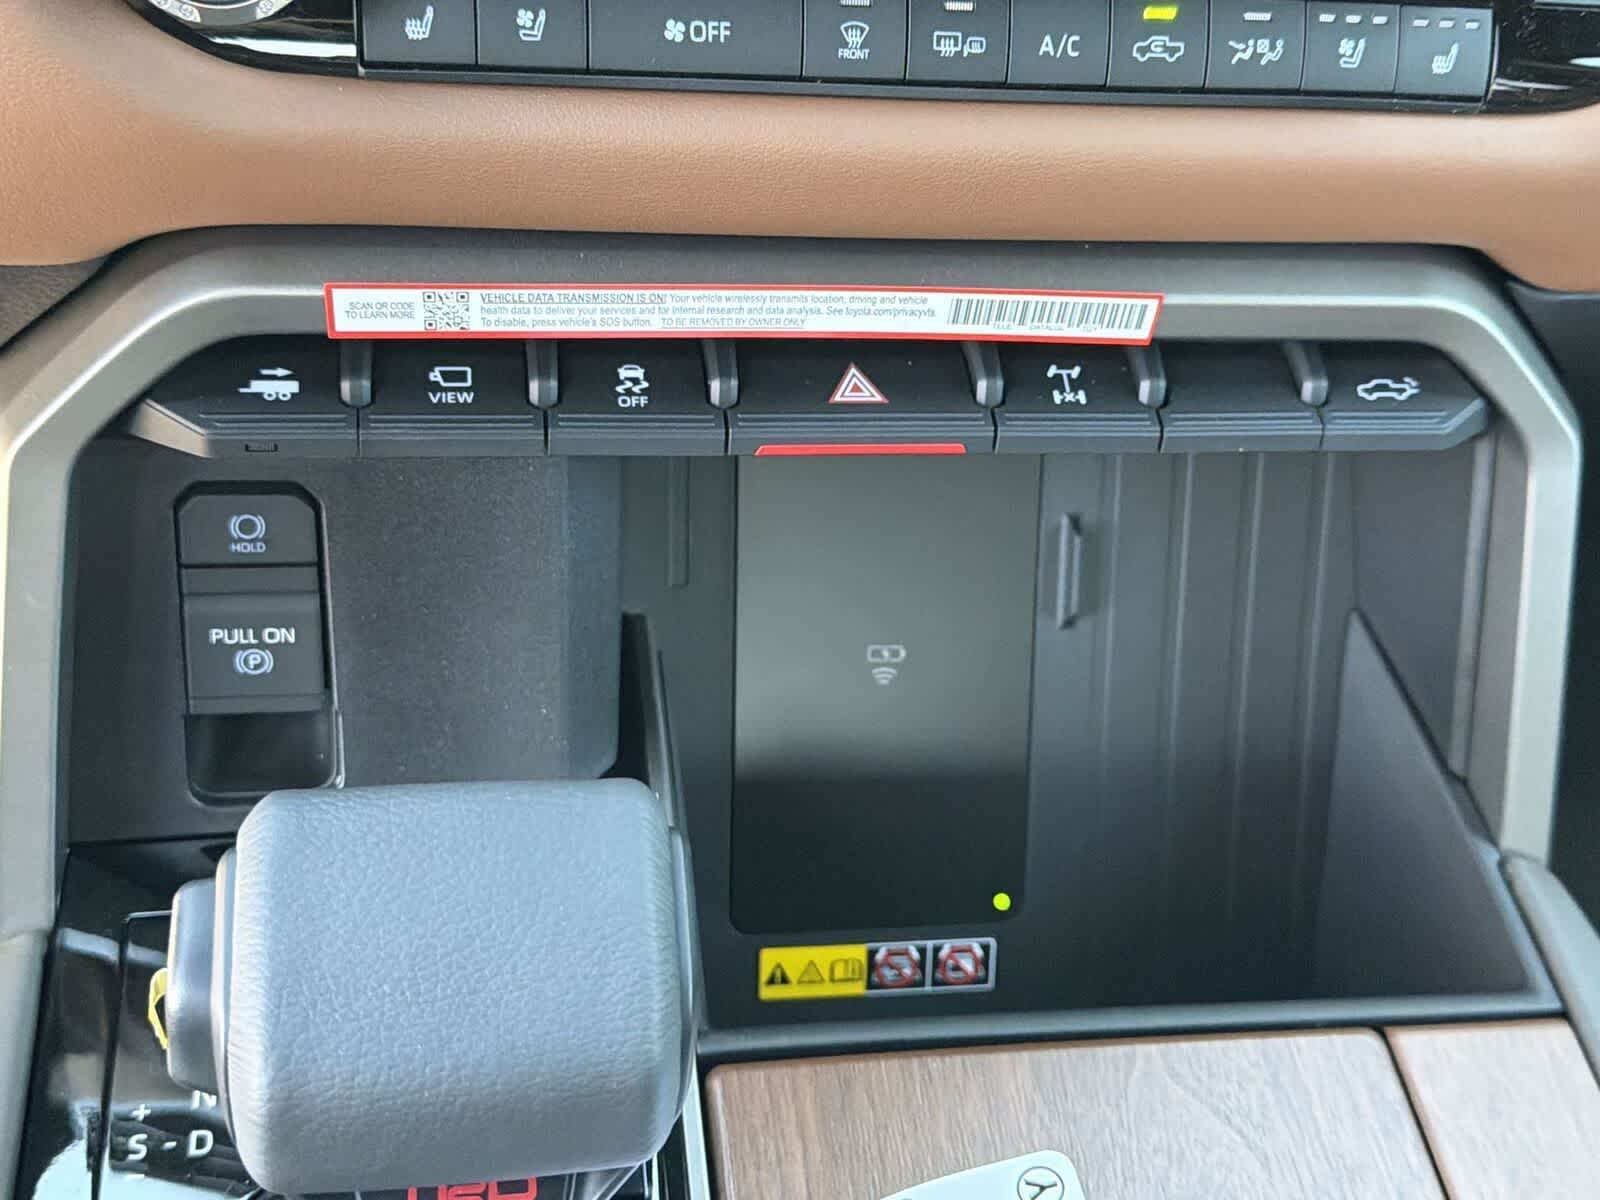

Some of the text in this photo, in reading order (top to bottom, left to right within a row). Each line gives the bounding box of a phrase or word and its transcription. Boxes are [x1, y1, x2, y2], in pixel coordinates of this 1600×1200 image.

[690, 21, 731, 43] OFF
[1039, 34, 1081, 57] A/C
[838, 49, 870, 60] FRONT
[480, 292, 524, 303] VEHICLE
[527, 292, 556, 303] DATA
[557, 293, 634, 303] TRANSMISSION
[637, 293, 647, 303] IS
[670, 294, 691, 303] Your
[692, 294, 723, 303] vehicle
[725, 294, 766, 305] wirelessly
[769, 295, 809, 304] transmits
[849, 296, 877, 306] driving
[879, 296, 897, 304] and
[898, 296, 928, 305] vehicle
[349, 302, 374, 310] SCAN
[390, 302, 415, 311] CODE
[480, 305, 508, 314] health
[511, 305, 531, 314] data
[533, 306, 543, 314] to
[545, 305, 575, 314] deliver
[577, 307, 597, 317] your
[600, 306, 636, 315] services
[639, 305, 656, 315] and
[658, 305, 669, 314] for
[672, 306, 705, 315] internal
[706, 306, 744, 315] research
[747, 306, 763, 315] and
[765, 306, 784, 315] data
[826, 306, 843, 316] See
[345, 311, 415, 320] TO LEARN MORE
[481, 317, 492, 327] To
[532, 319, 556, 329] press
[559, 318, 597, 327] vehicle's
[599, 318, 621, 327] SOS
[661, 318, 807, 328] TO BE REMOVED BY OWNER ONLY
[428, 391, 474, 404] VIEW
[618, 396, 649, 408] OFF
[231, 542, 266, 553] HOLD
[209, 627, 296, 644] PULL ON
[127, 1133, 148, 1160] S
[186, 1129, 214, 1158] D
